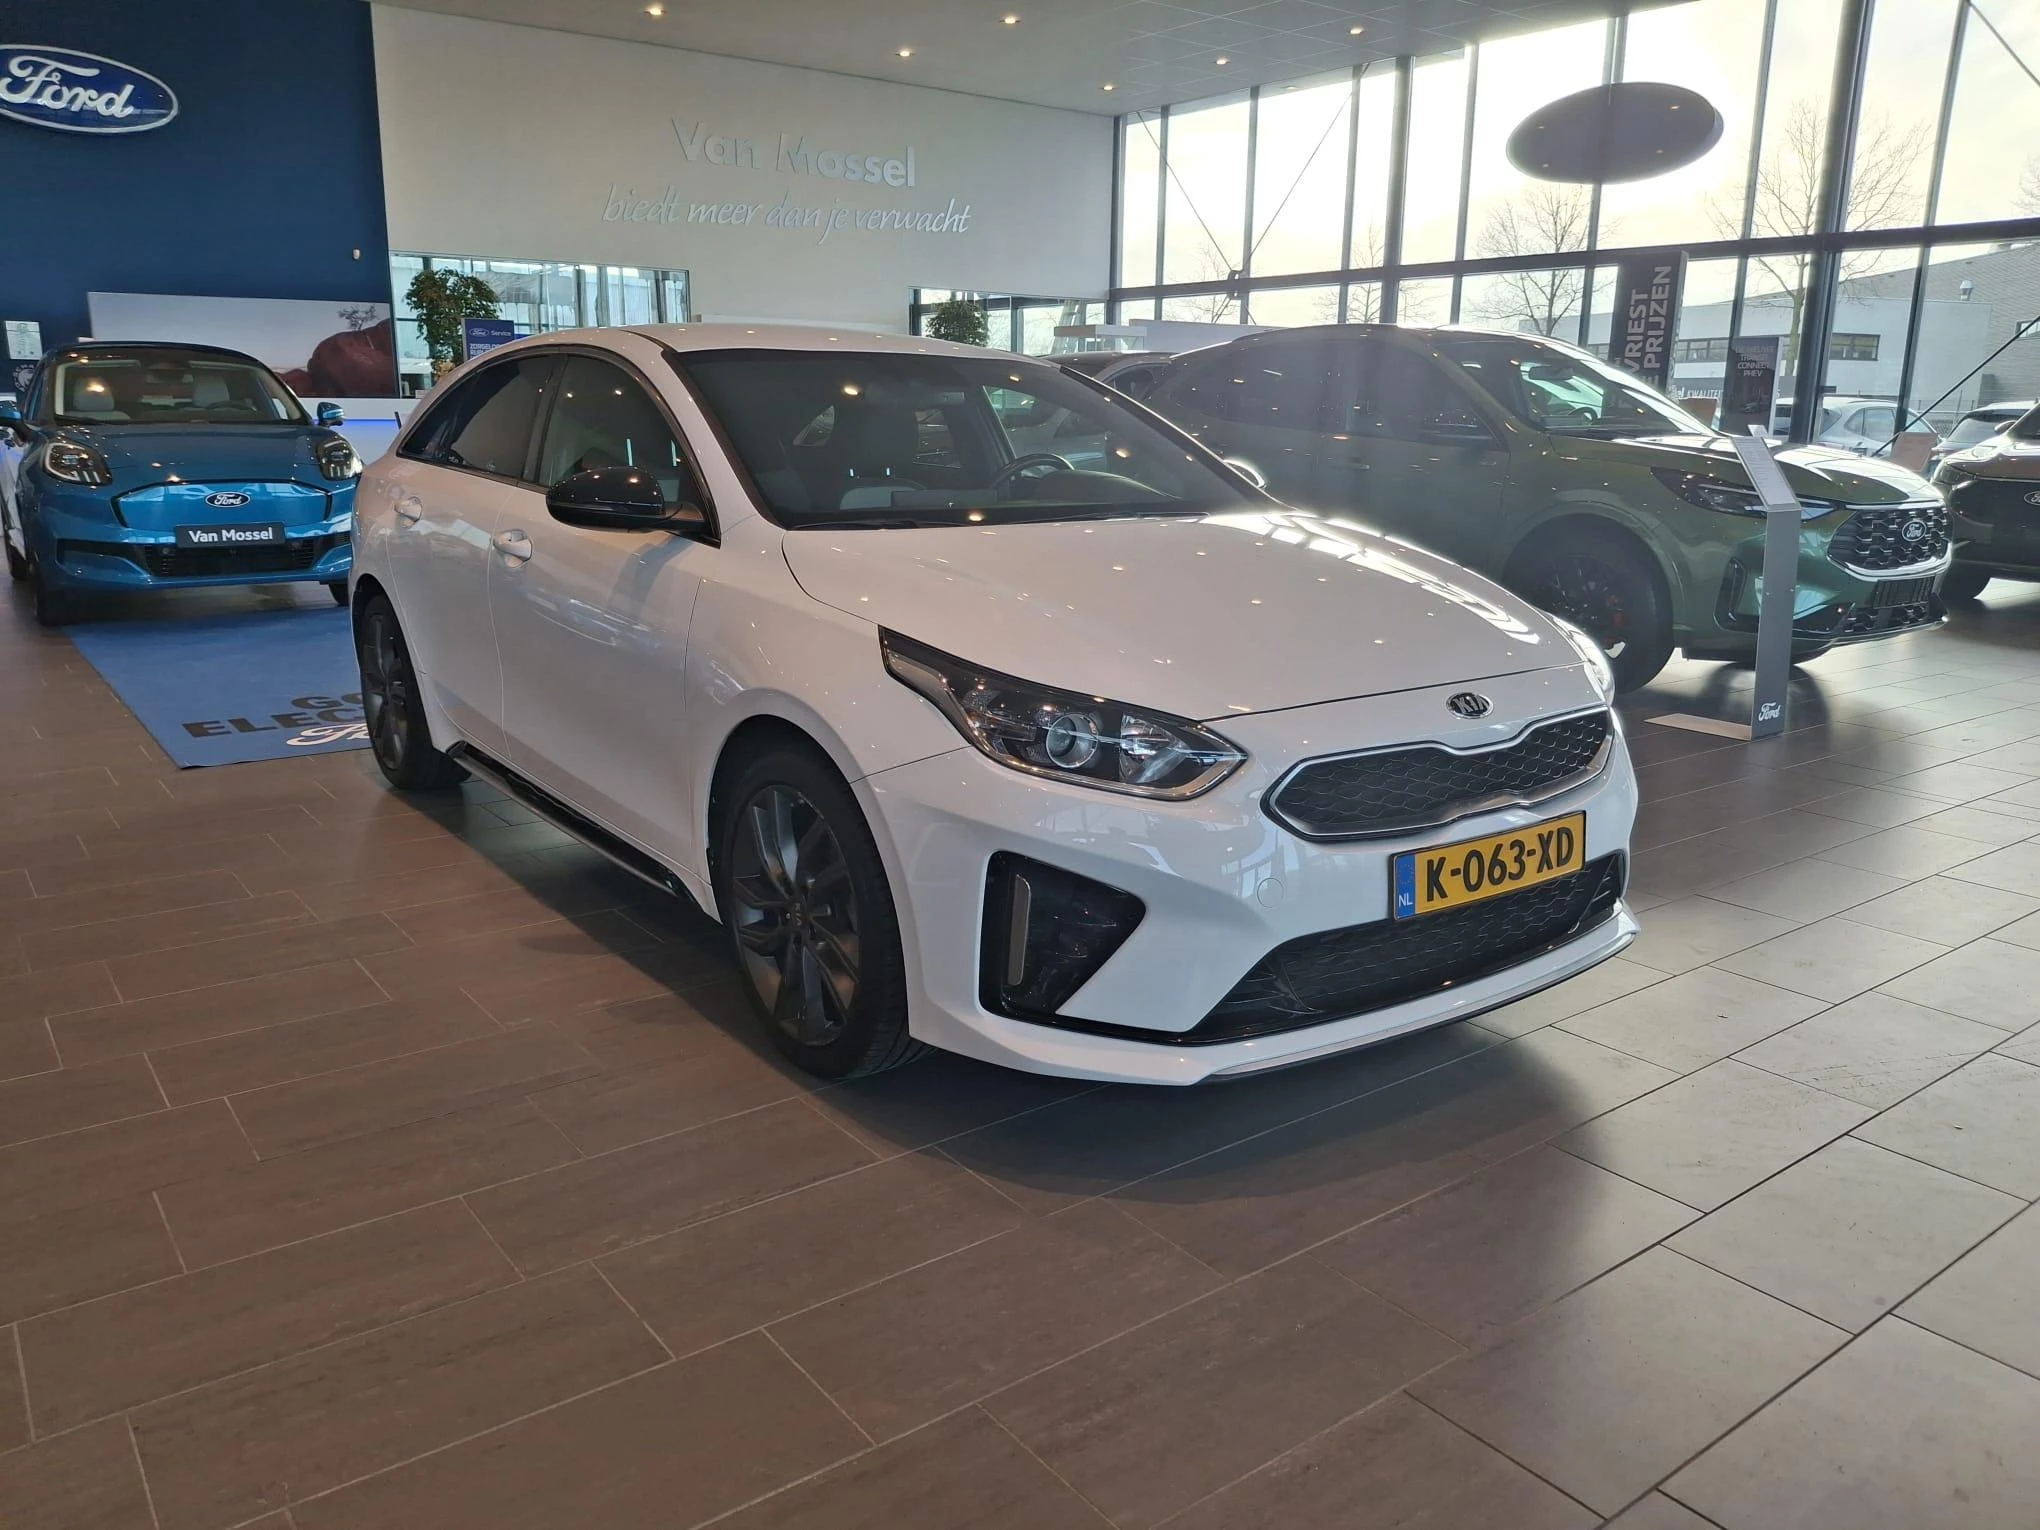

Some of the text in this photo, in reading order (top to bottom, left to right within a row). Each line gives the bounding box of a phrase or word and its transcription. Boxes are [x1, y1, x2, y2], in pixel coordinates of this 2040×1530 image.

[0, 55, 135, 118] Ford
[671, 117, 916, 188] Van Mossel
[601, 182, 972, 246] biedt meer dan je verwacht
[1623, 288, 1648, 373] VRIEST
[1643, 265, 1672, 369] PRIJZEN
[214, 492, 242, 505] Ford
[188, 526, 273, 543] Van Mossel
[181, 707, 365, 738] ELEC
[1758, 702, 1781, 721] Ford
[1426, 826, 1575, 902] K-063-XD
[1398, 891, 1413, 908] NL
